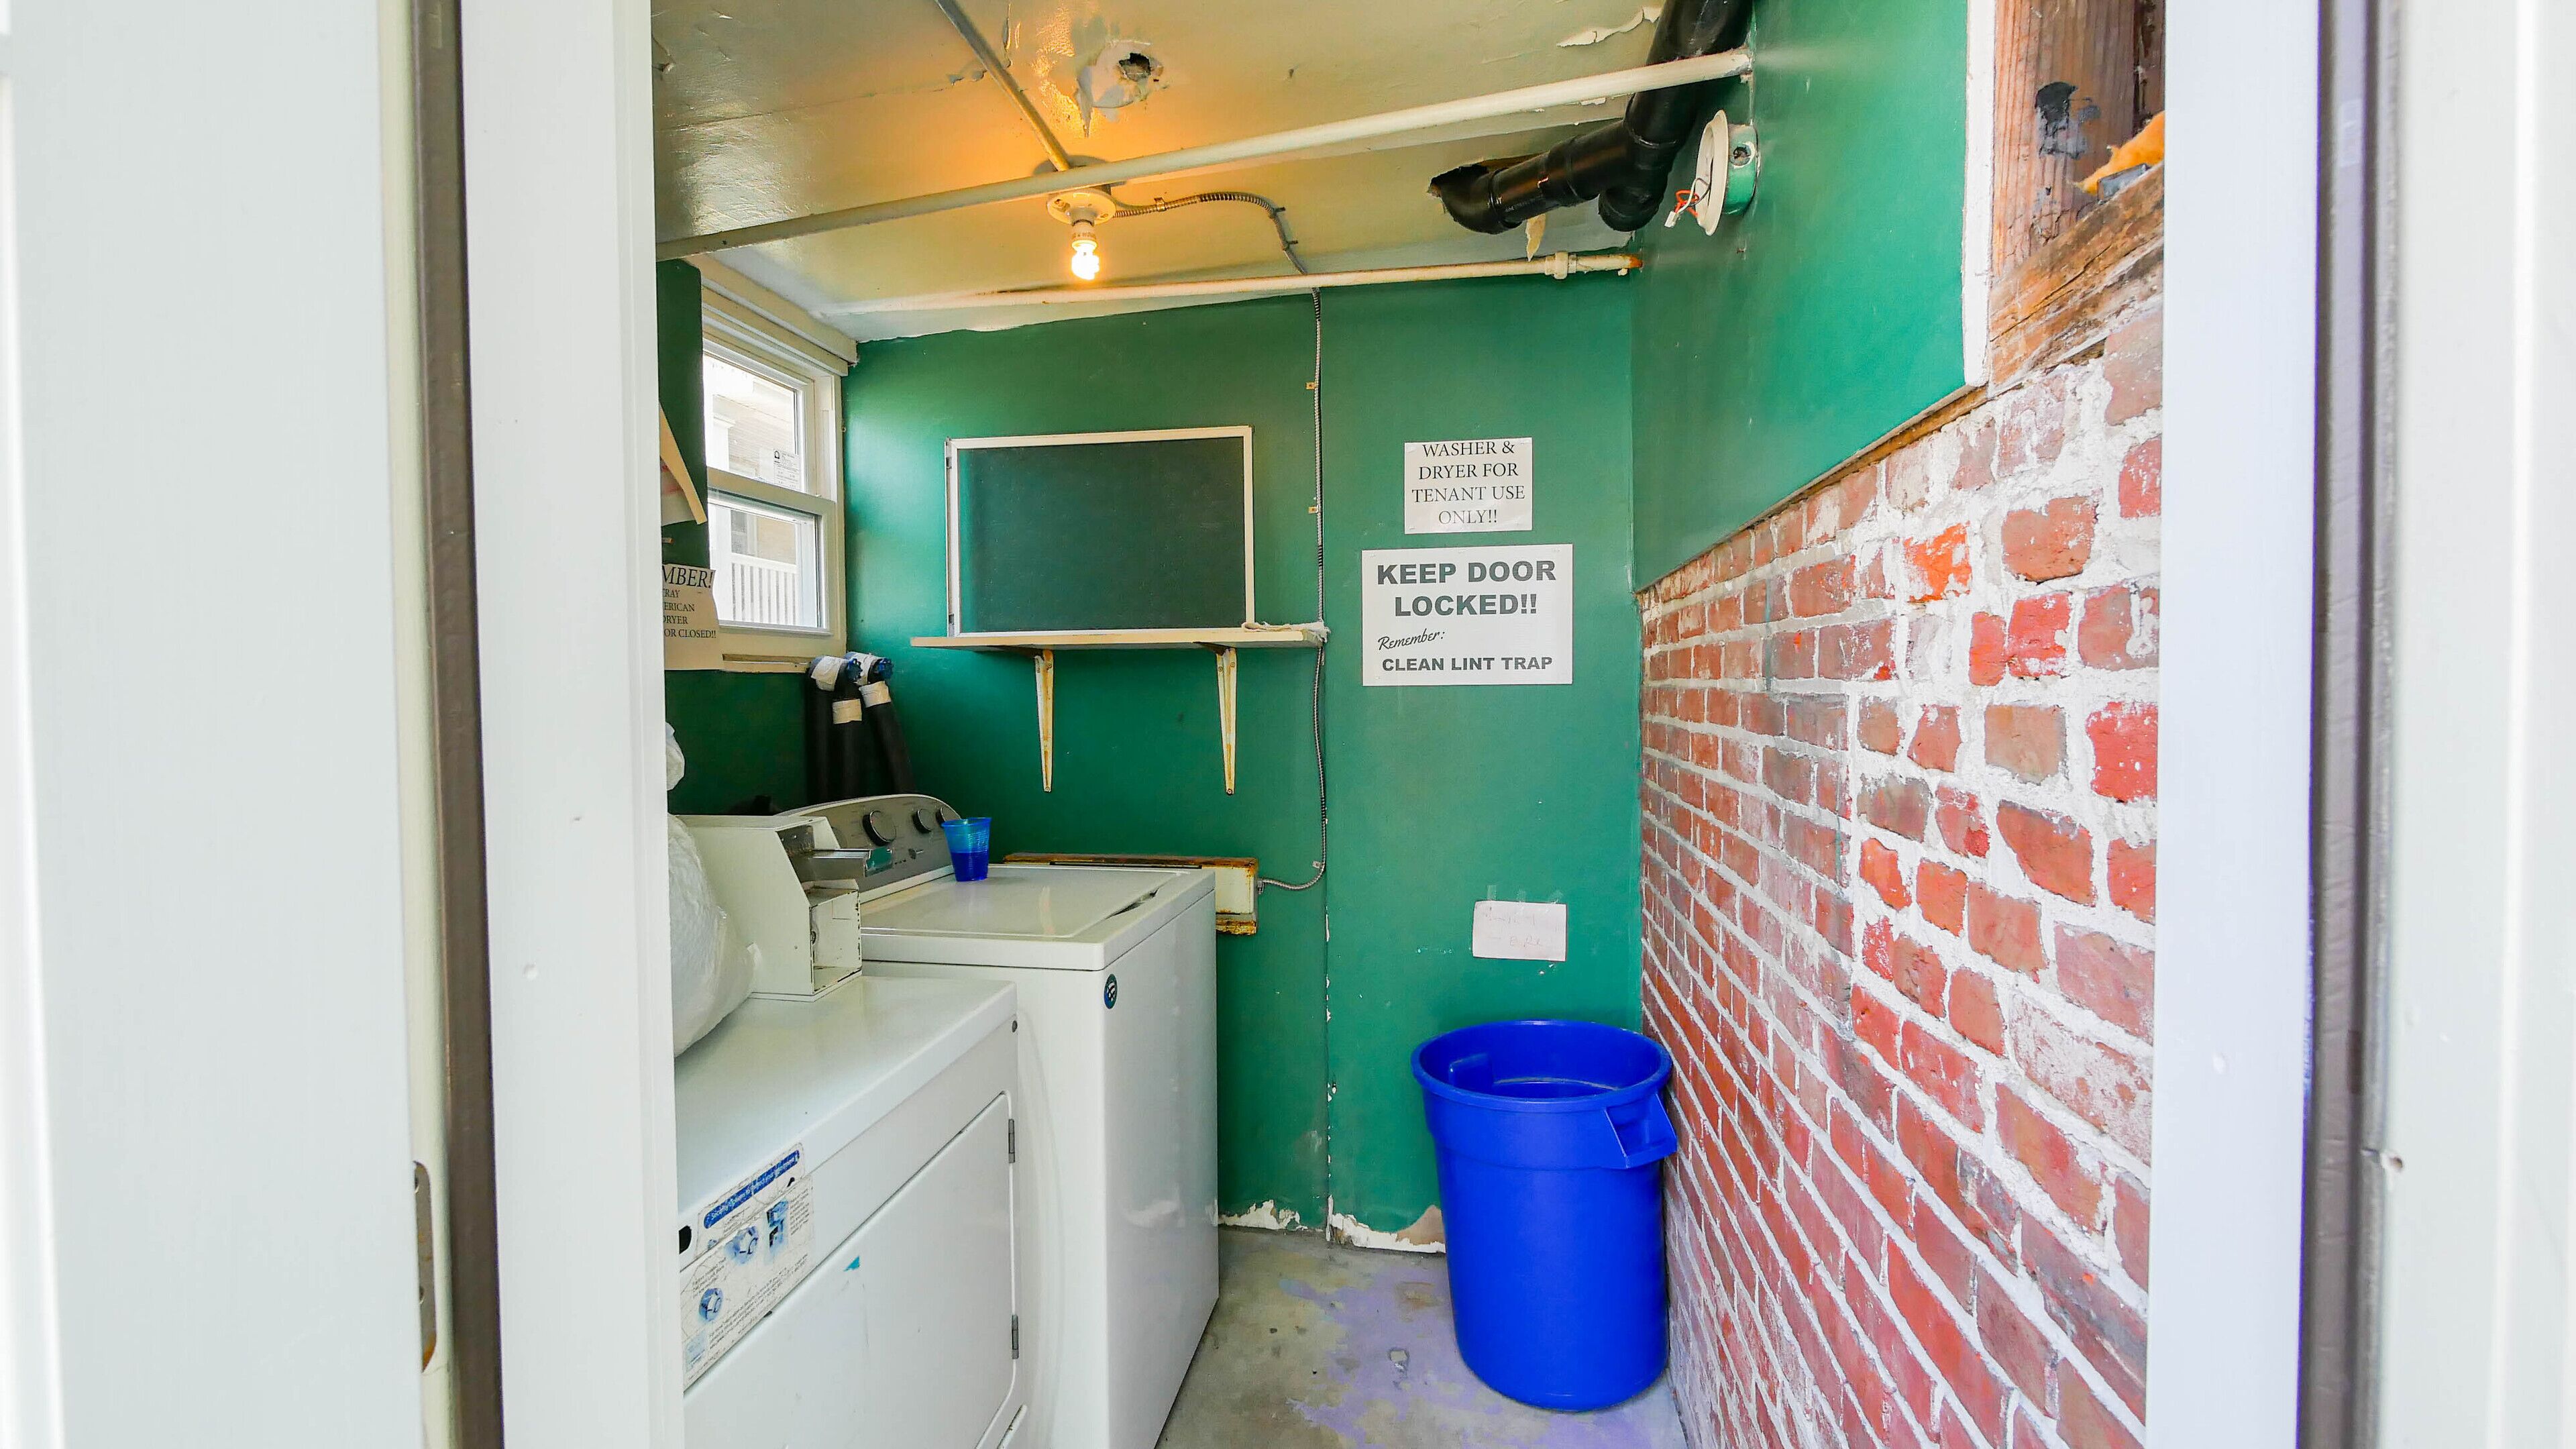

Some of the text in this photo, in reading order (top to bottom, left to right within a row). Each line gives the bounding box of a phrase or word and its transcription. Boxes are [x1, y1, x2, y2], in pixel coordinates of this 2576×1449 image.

[1423, 441, 1515, 458] WASHER &
[1419, 462, 1519, 480] DRYER FOR
[1412, 486, 1525, 503] TENANT USE
[1438, 509, 1497, 525] ONLY!!
[1377, 561, 1556, 585] KEEP DOOR
[663, 602, 695, 612] ERICAN
[1395, 594, 1537, 616] LOCKED!!
[678, 629, 716, 639] CLOSED!!
[1378, 629, 1445, 651] Remember:
[1382, 656, 1553, 672] CLEAN LINT TRAP
